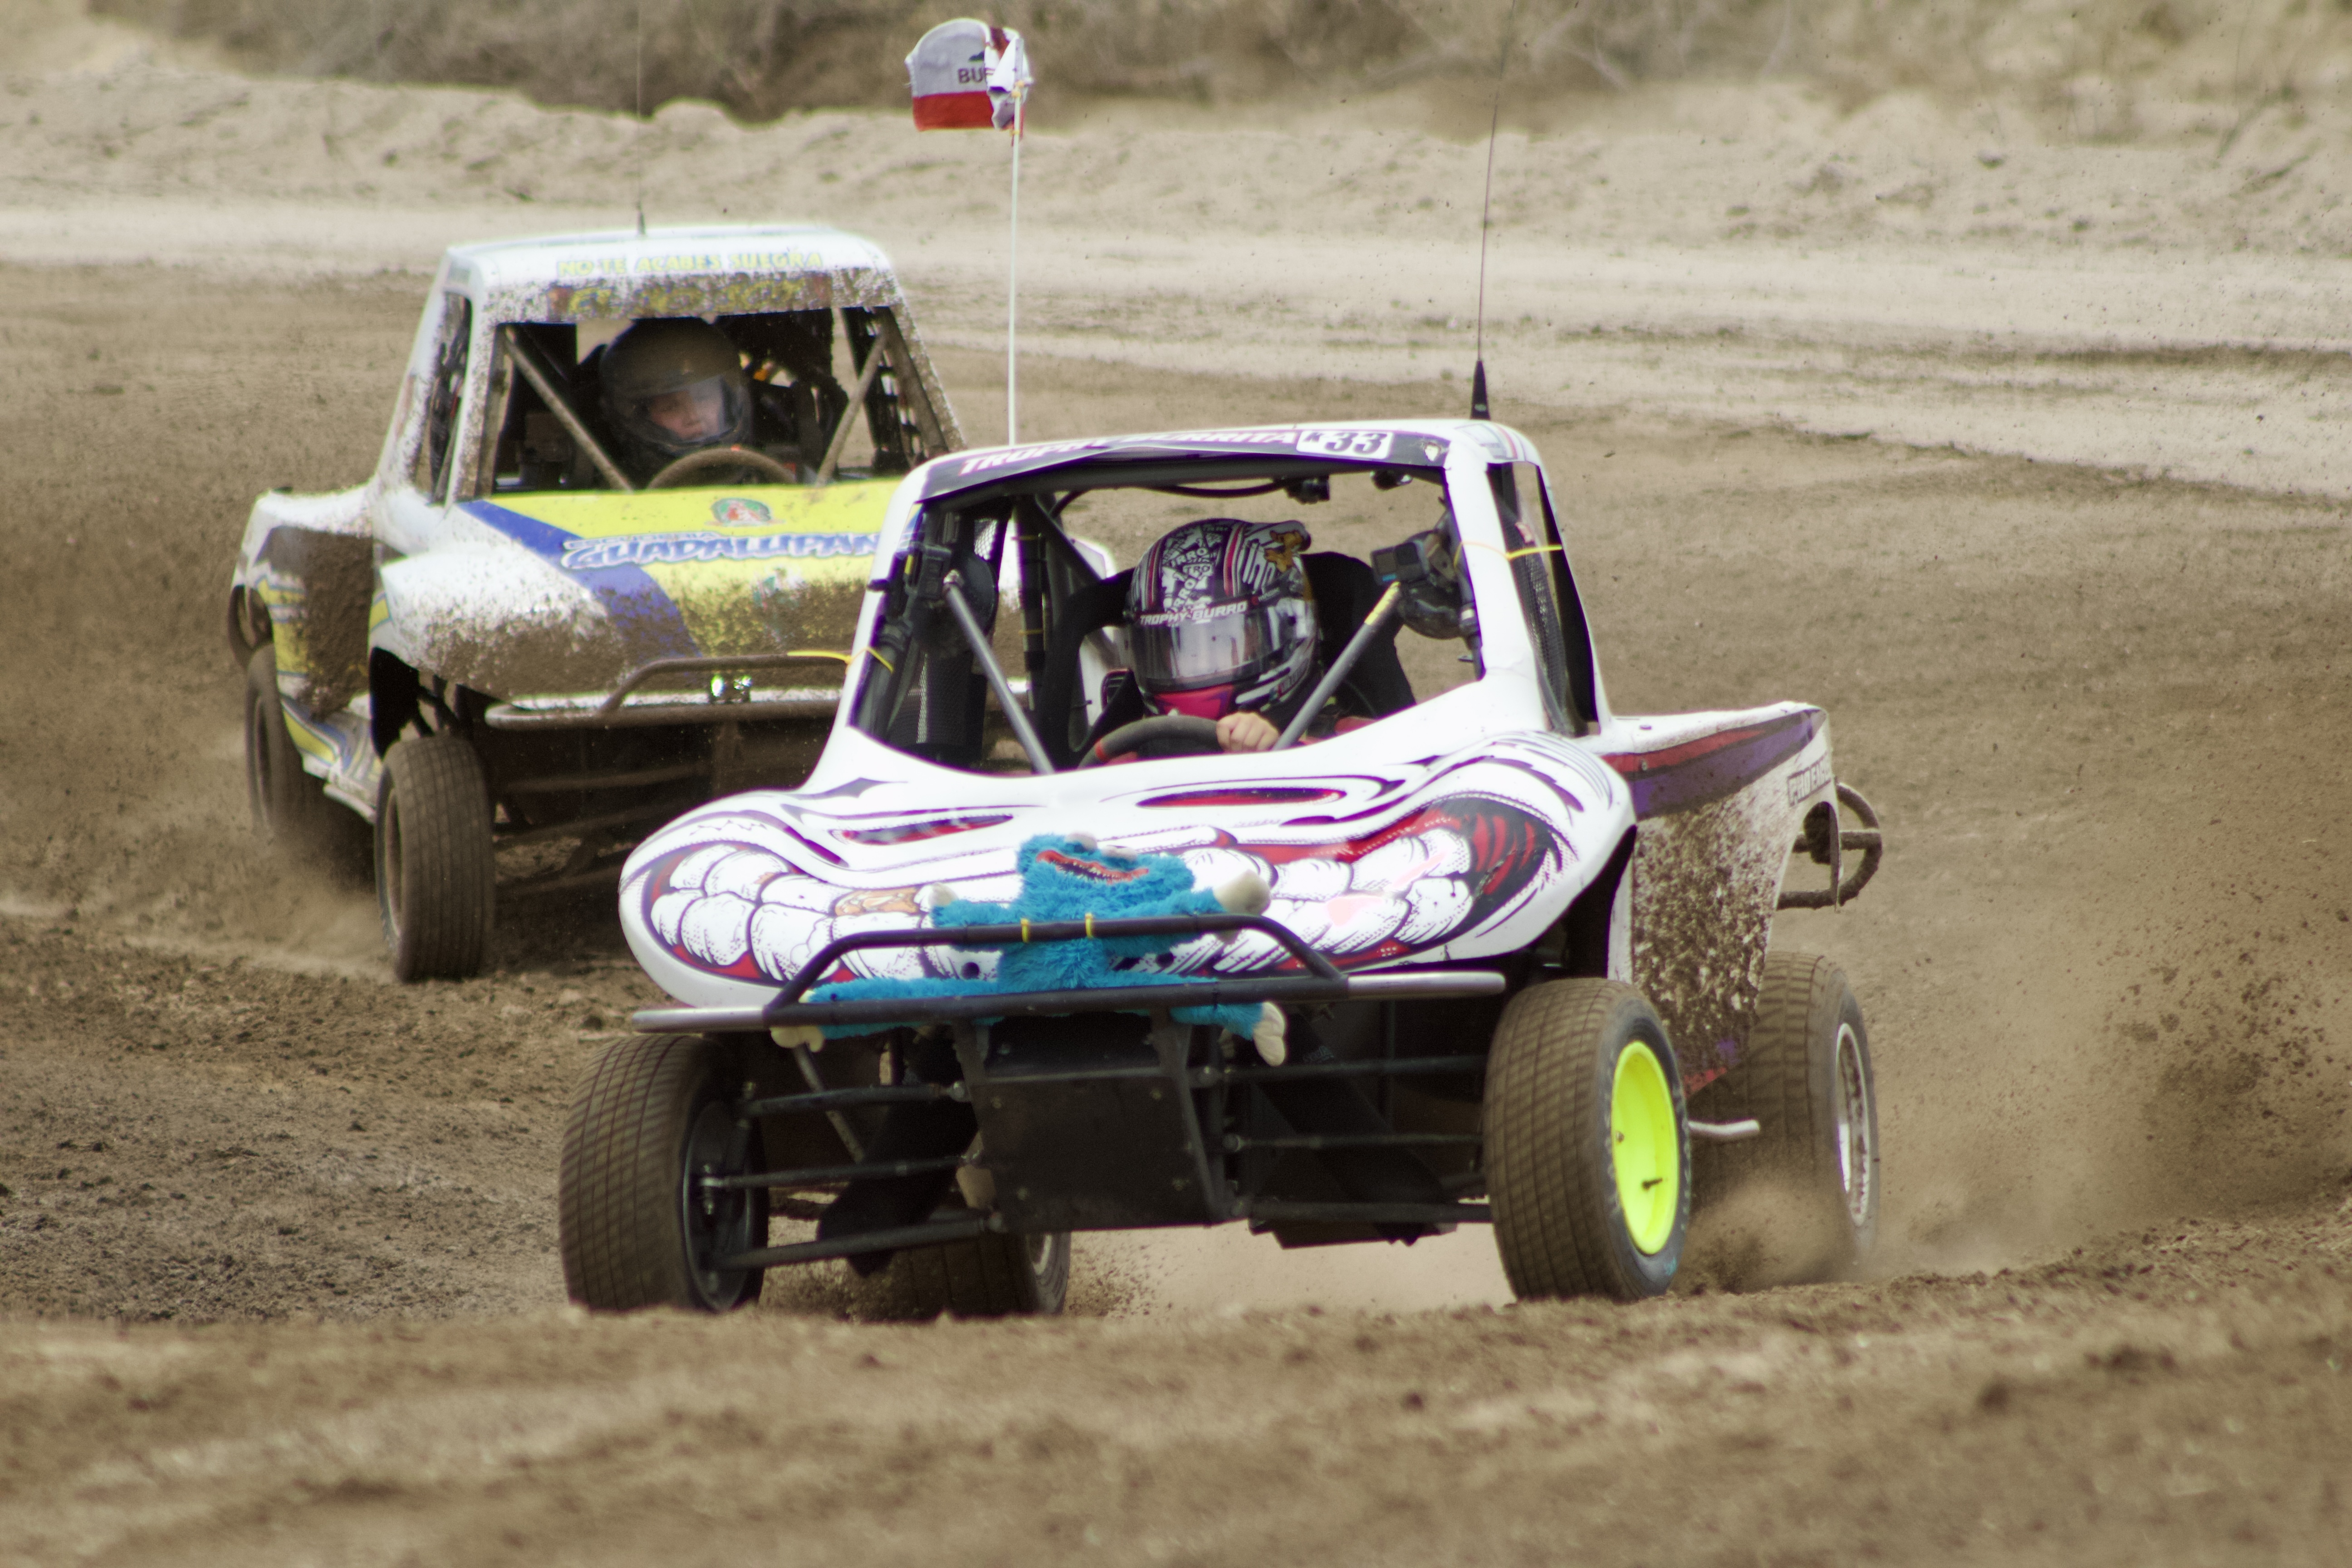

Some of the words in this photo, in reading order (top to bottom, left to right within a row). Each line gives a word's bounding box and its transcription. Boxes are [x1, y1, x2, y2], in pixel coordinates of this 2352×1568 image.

[557, 260, 593, 276] NO
[598, 258, 626, 274] TE
[635, 255, 720, 272] ACABES
[728, 251, 823, 269] SUEGRA
[1324, 432, 1388, 454] 33
[562, 533, 882, 569] GUADALUPAN
